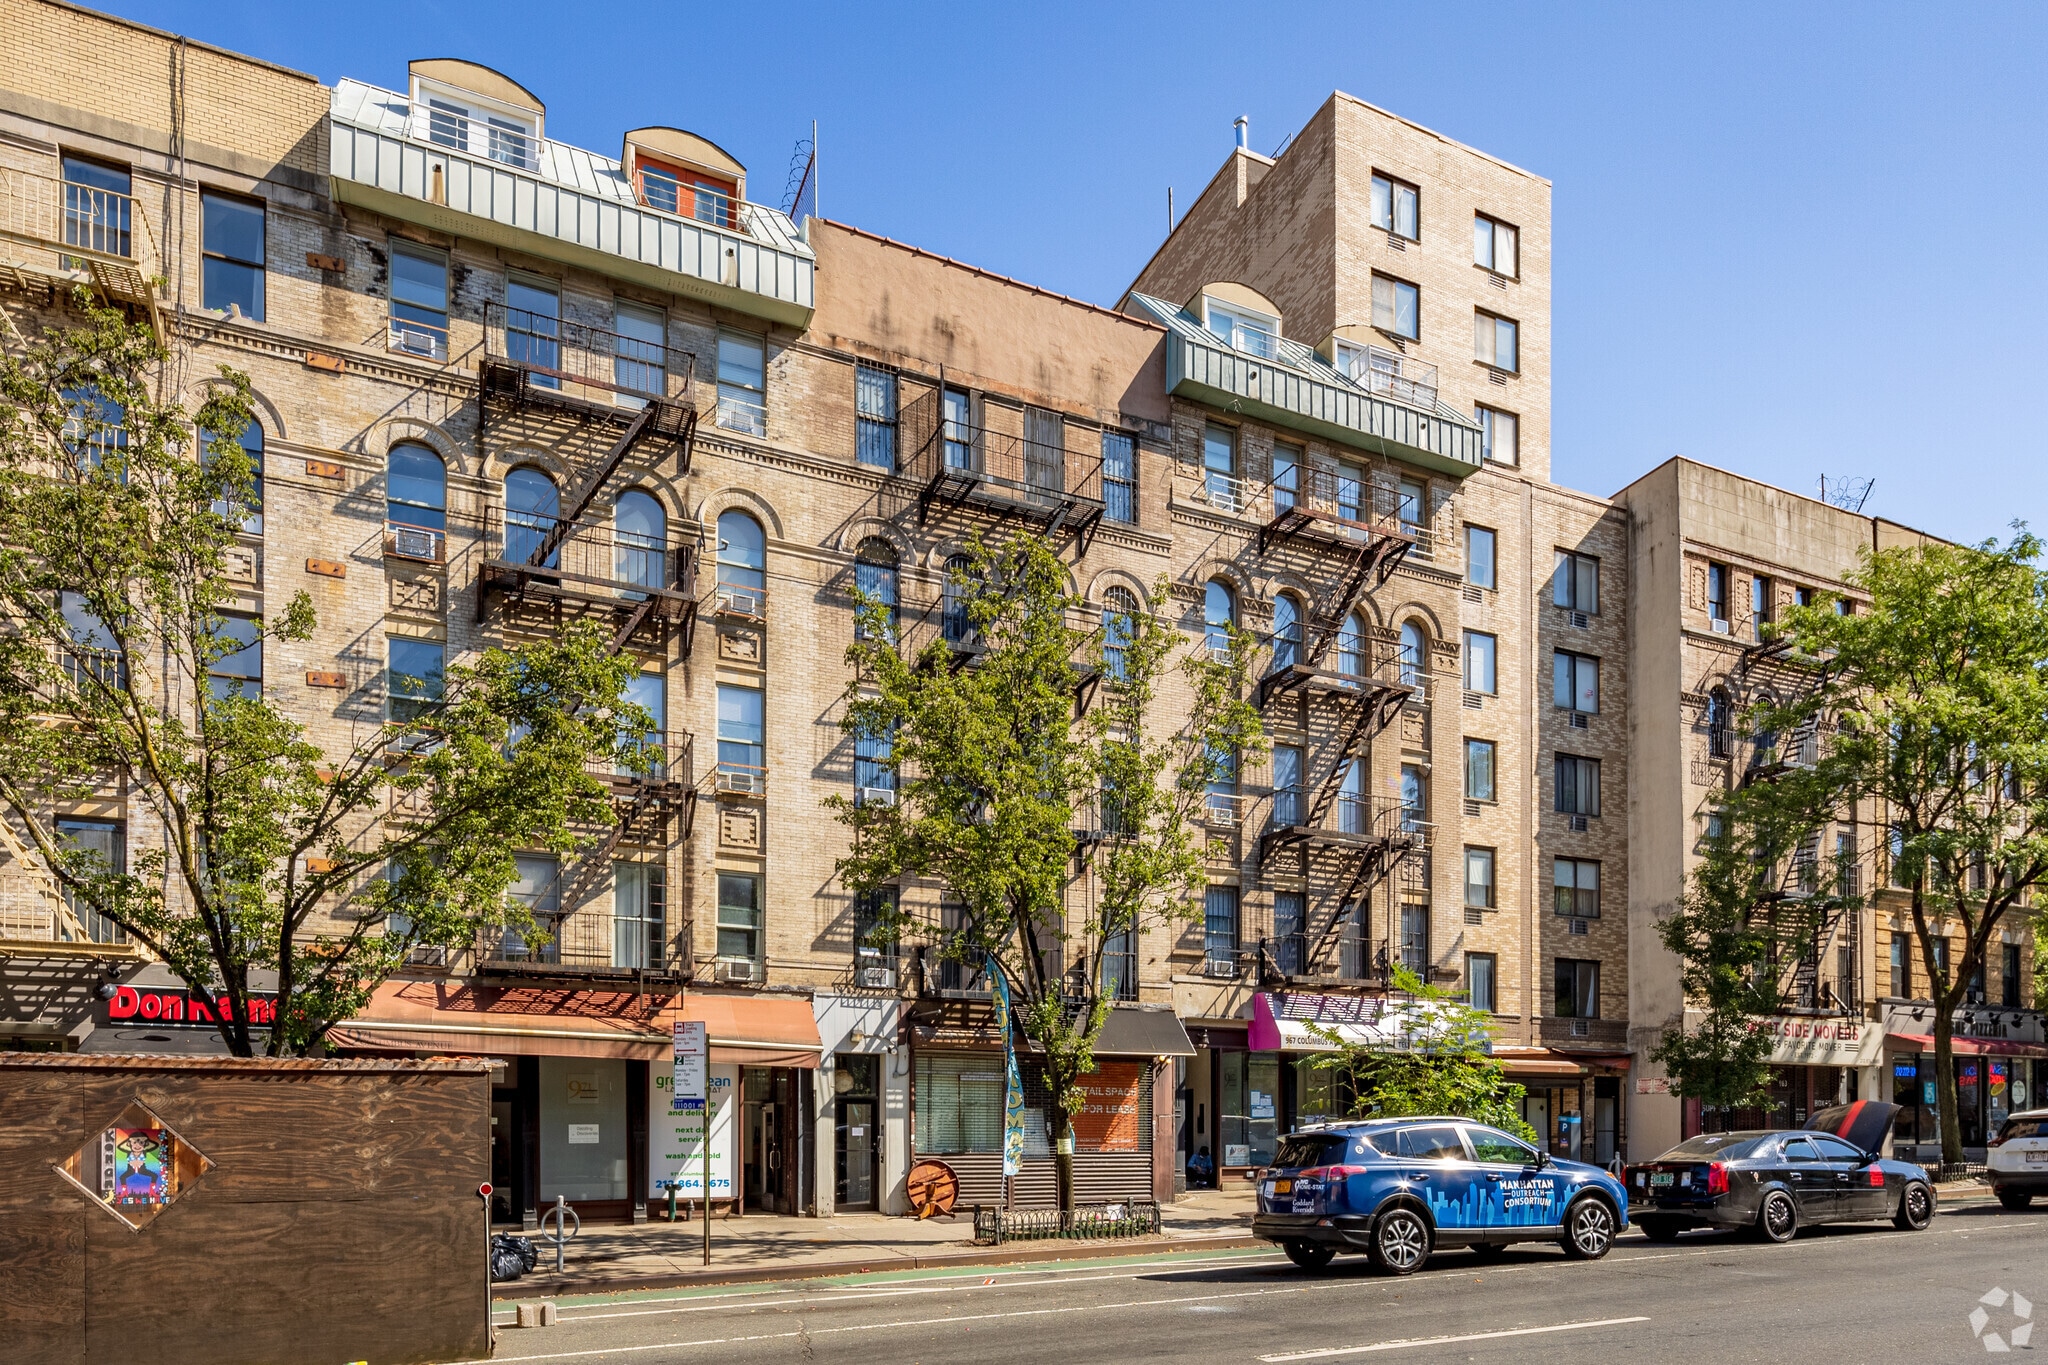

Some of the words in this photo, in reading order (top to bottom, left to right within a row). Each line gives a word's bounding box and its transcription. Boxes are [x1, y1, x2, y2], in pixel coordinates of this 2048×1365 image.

[109, 985, 183, 1020] Don
[1784, 1023, 1809, 1038] SIDE
[1814, 1024, 1859, 1040] MOVERS
[417, 1040, 453, 1049] AVENUE
[1297, 1037, 1328, 1045] COLUMBUS
[1784, 1041, 1816, 1051] FAVORITE
[1819, 1043, 1842, 1052] MOVER
[1105, 1087, 1137, 1096] SPACE
[1083, 1105, 1103, 1113] FOR
[1106, 1105, 1136, 1114] LEASE
[1499, 1179, 1554, 1190] MANHATTAN
[1511, 1189, 1545, 1198] OUTREACH
[1504, 1197, 1552, 1208] CONSORTIUM
